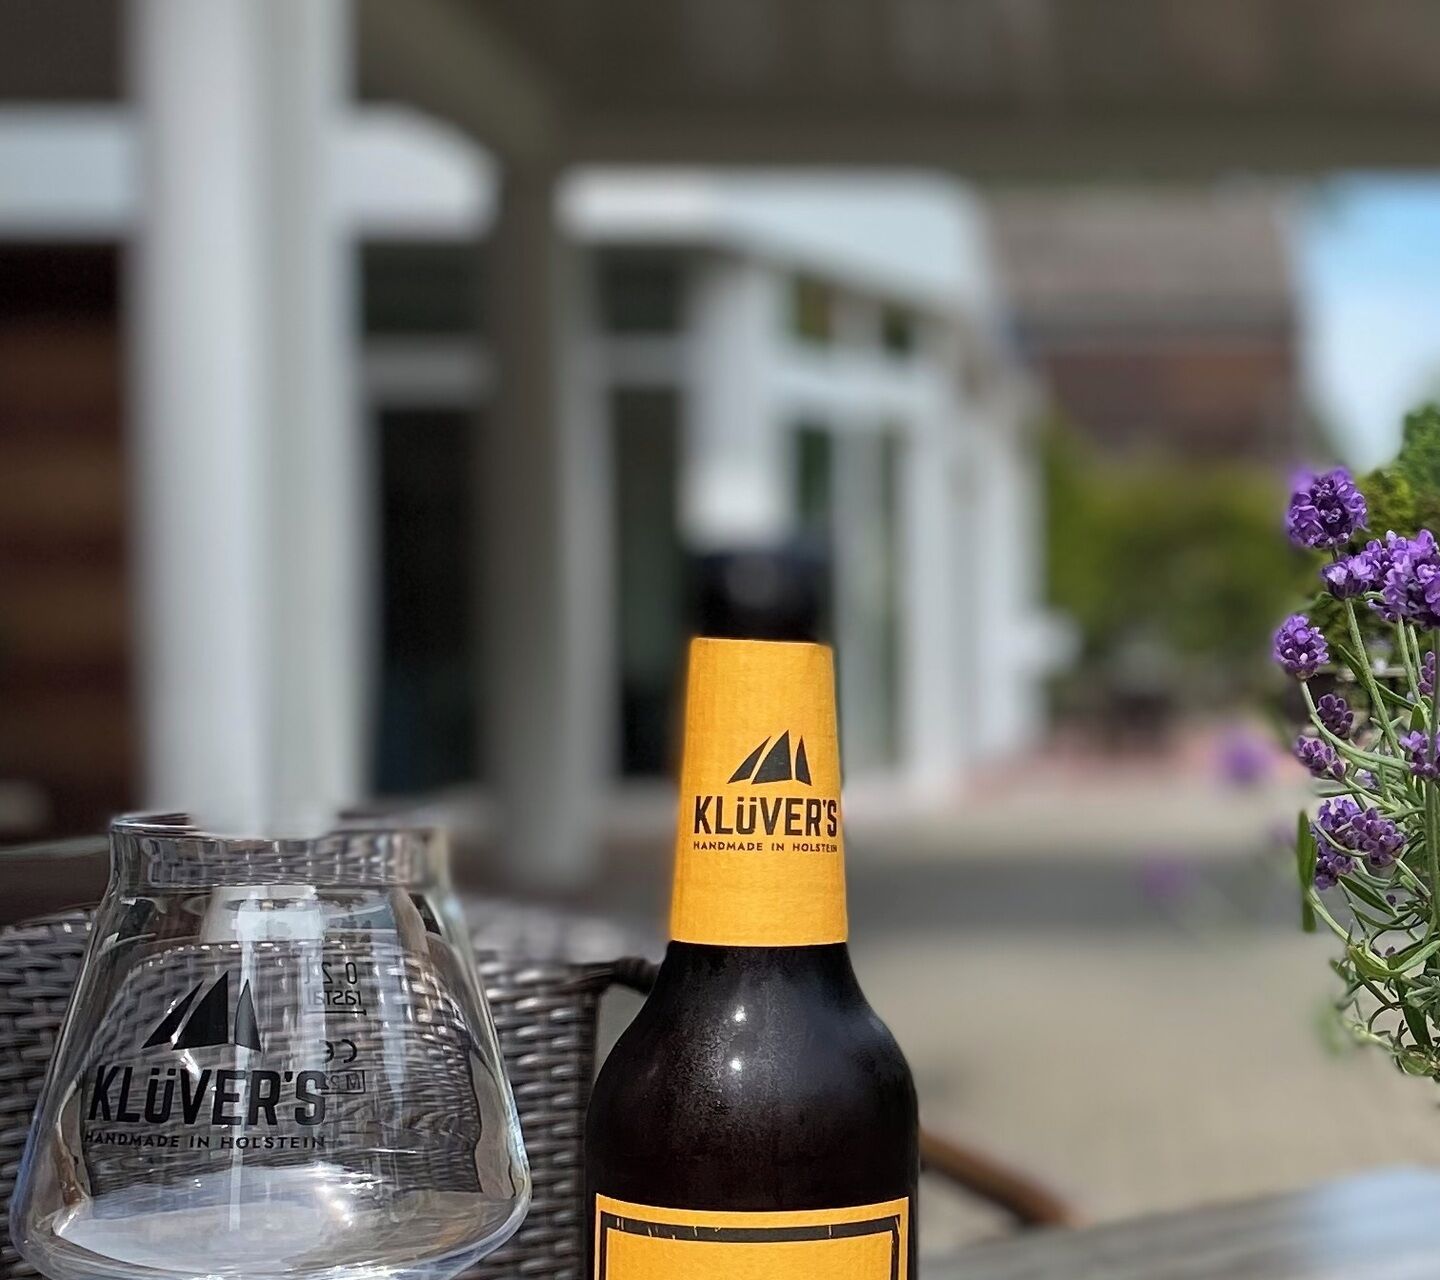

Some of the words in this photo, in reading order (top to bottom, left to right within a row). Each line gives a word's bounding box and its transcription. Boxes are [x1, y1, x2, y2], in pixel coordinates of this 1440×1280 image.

[693, 841, 763, 851] HANDMADE
[771, 842, 785, 851] IN
[792, 843, 838, 853] HOLSTEIN
[84, 1130, 180, 1148] HANDMADE
[189, 1136, 210, 1148] IN
[220, 1136, 326, 1150] HOLSTEIN
